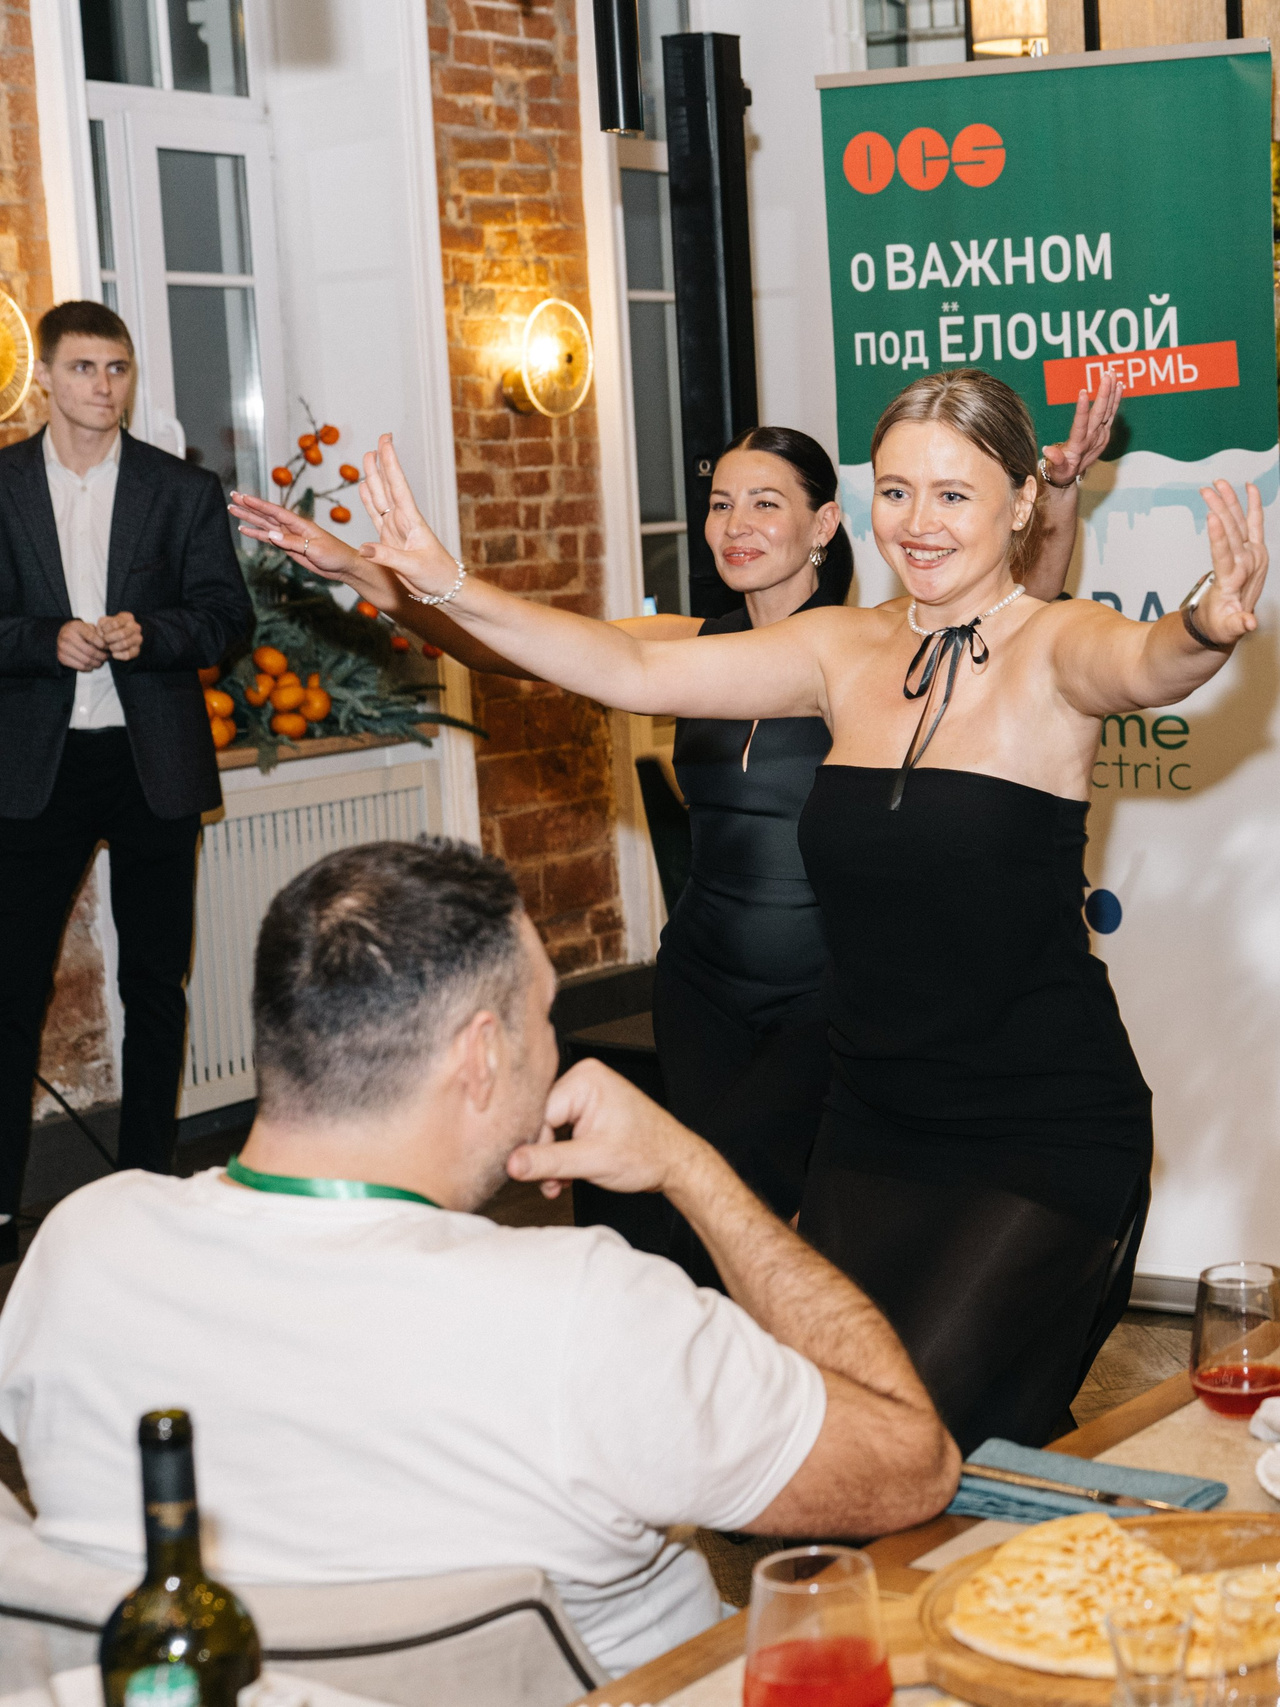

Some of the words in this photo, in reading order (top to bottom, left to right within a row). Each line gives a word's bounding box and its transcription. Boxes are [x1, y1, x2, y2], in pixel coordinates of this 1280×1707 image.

[843, 123, 1006, 194] OCS
[886, 232, 1112, 291] ВАЖНОМ
[854, 330, 929, 370] под
[939, 293, 1180, 363] ЁЛОЧКОЙ
